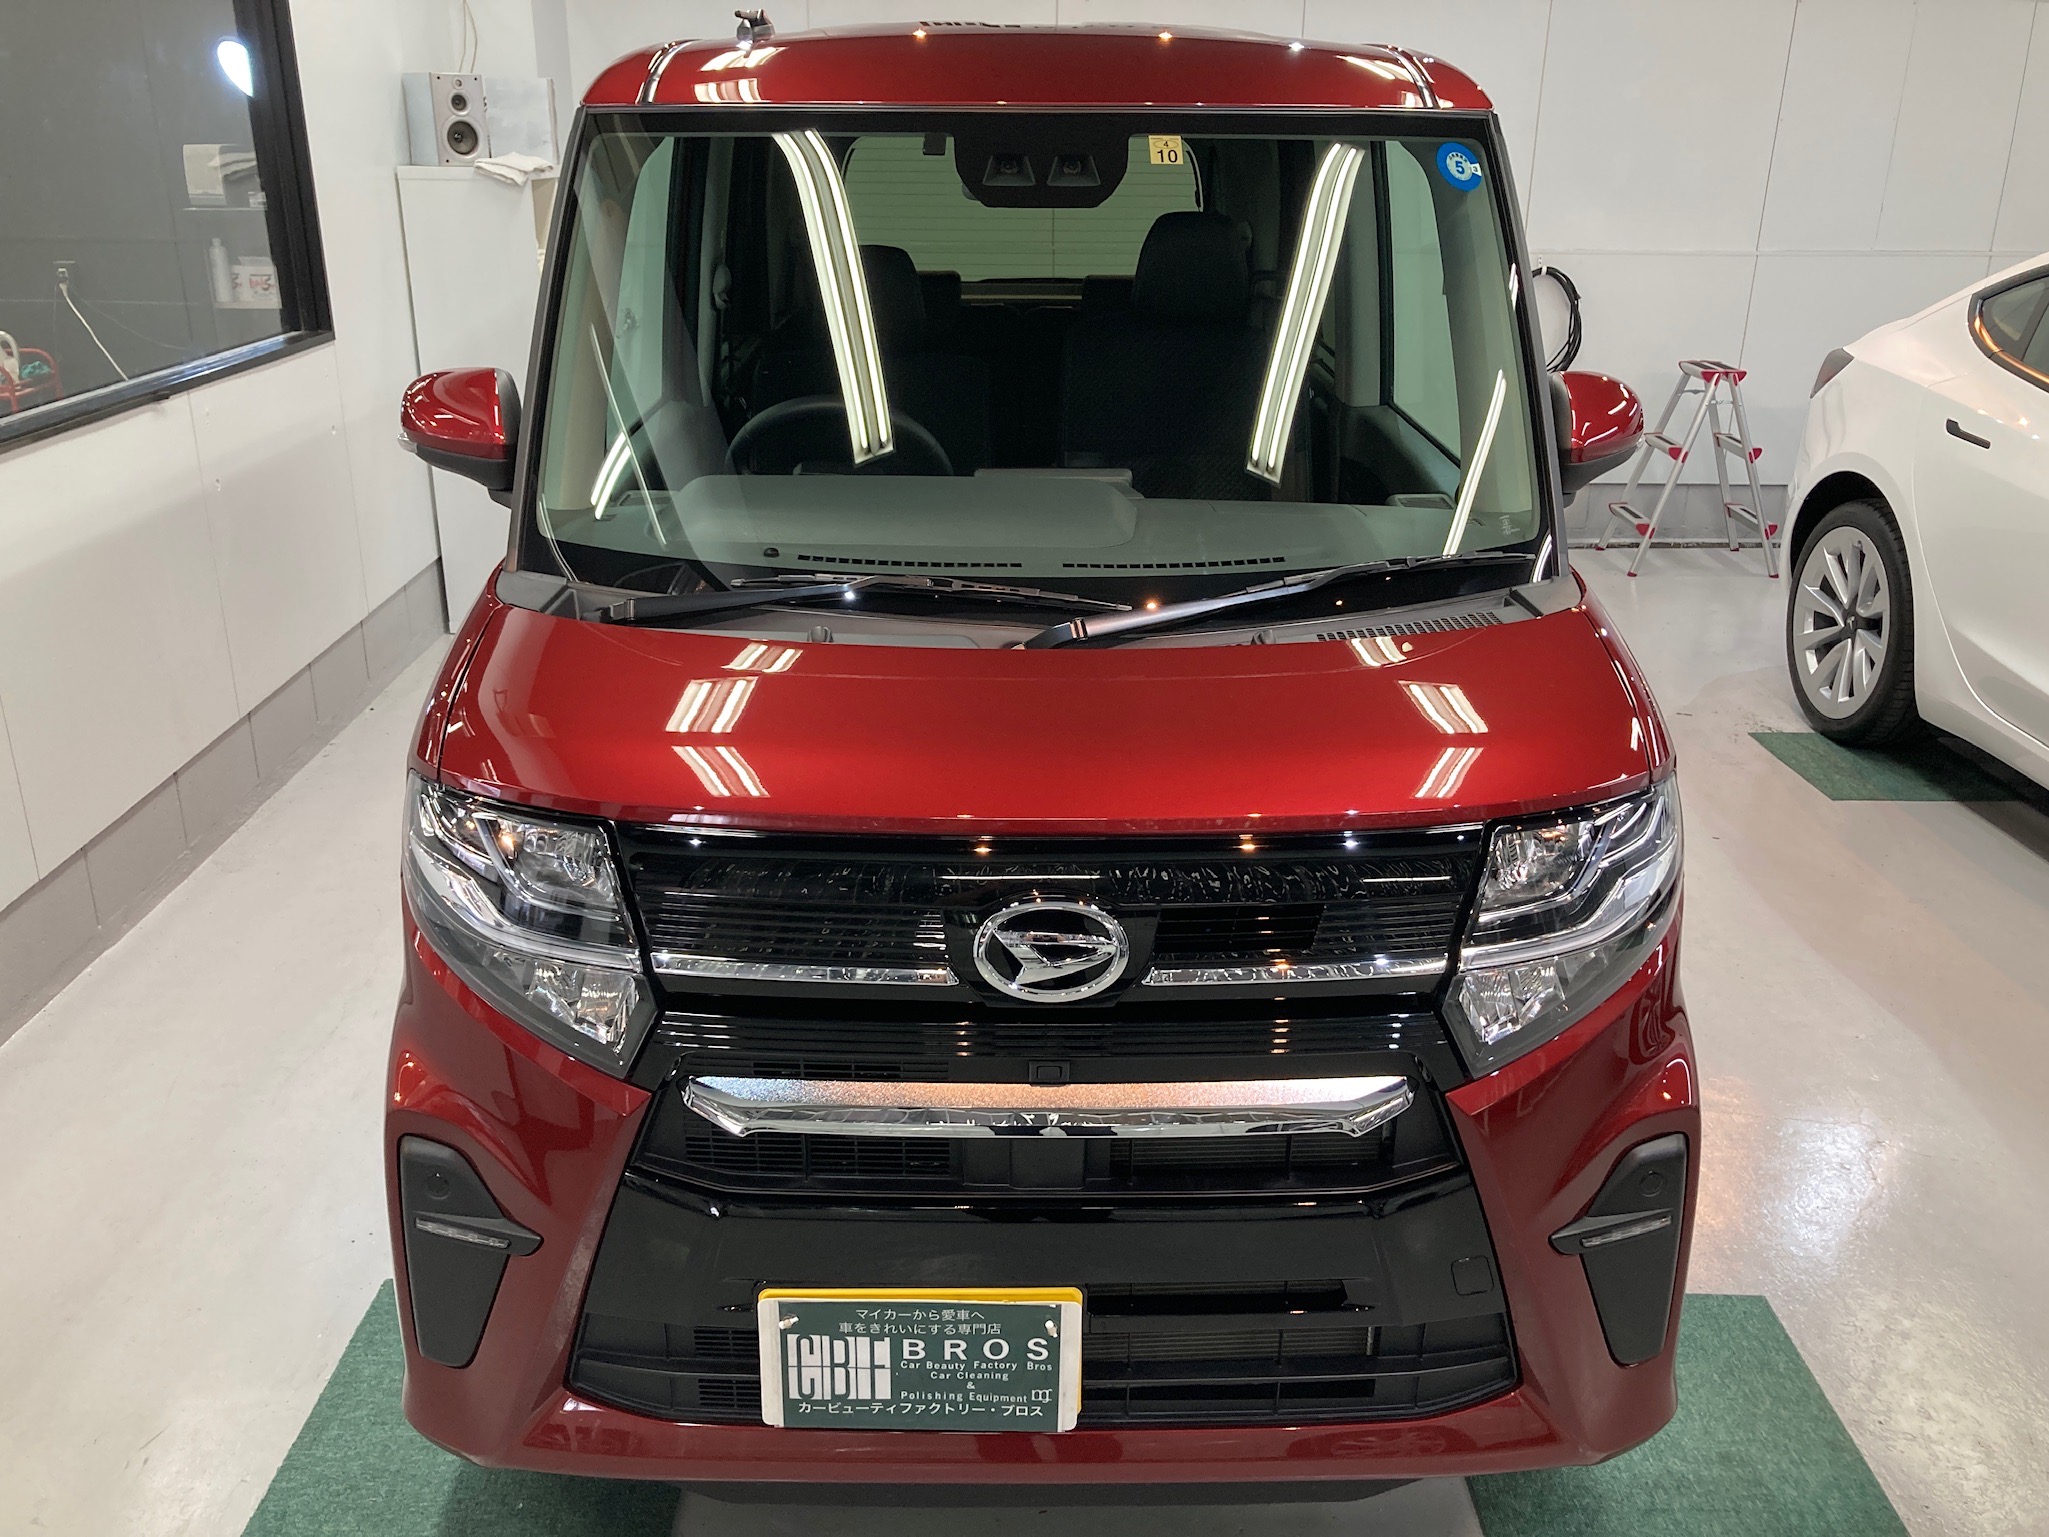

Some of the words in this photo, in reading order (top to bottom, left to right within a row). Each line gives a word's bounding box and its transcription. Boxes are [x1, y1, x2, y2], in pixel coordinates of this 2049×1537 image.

[1157, 149, 1178, 163] 10
[1455, 160, 1465, 175] 5
[856, 1309, 985, 1321] マイカーから愛車へ
[839, 1322, 1001, 1335] 車をきれいにする専門店
[902, 1338, 1049, 1361] BROS
[900, 1361, 921, 1369] Car
[926, 1361, 965, 1371] Beauty
[973, 1361, 1018, 1371] Factory
[1026, 1362, 1052, 1371] Bros
[957, 1372, 1009, 1381] Cleaning
[966, 1382, 975, 1390] &
[901, 1391, 963, 1401] Polishing
[969, 1392, 1027, 1403] Equipment
[799, 1402, 1043, 1417] カービューティファクトリー・ブロス
